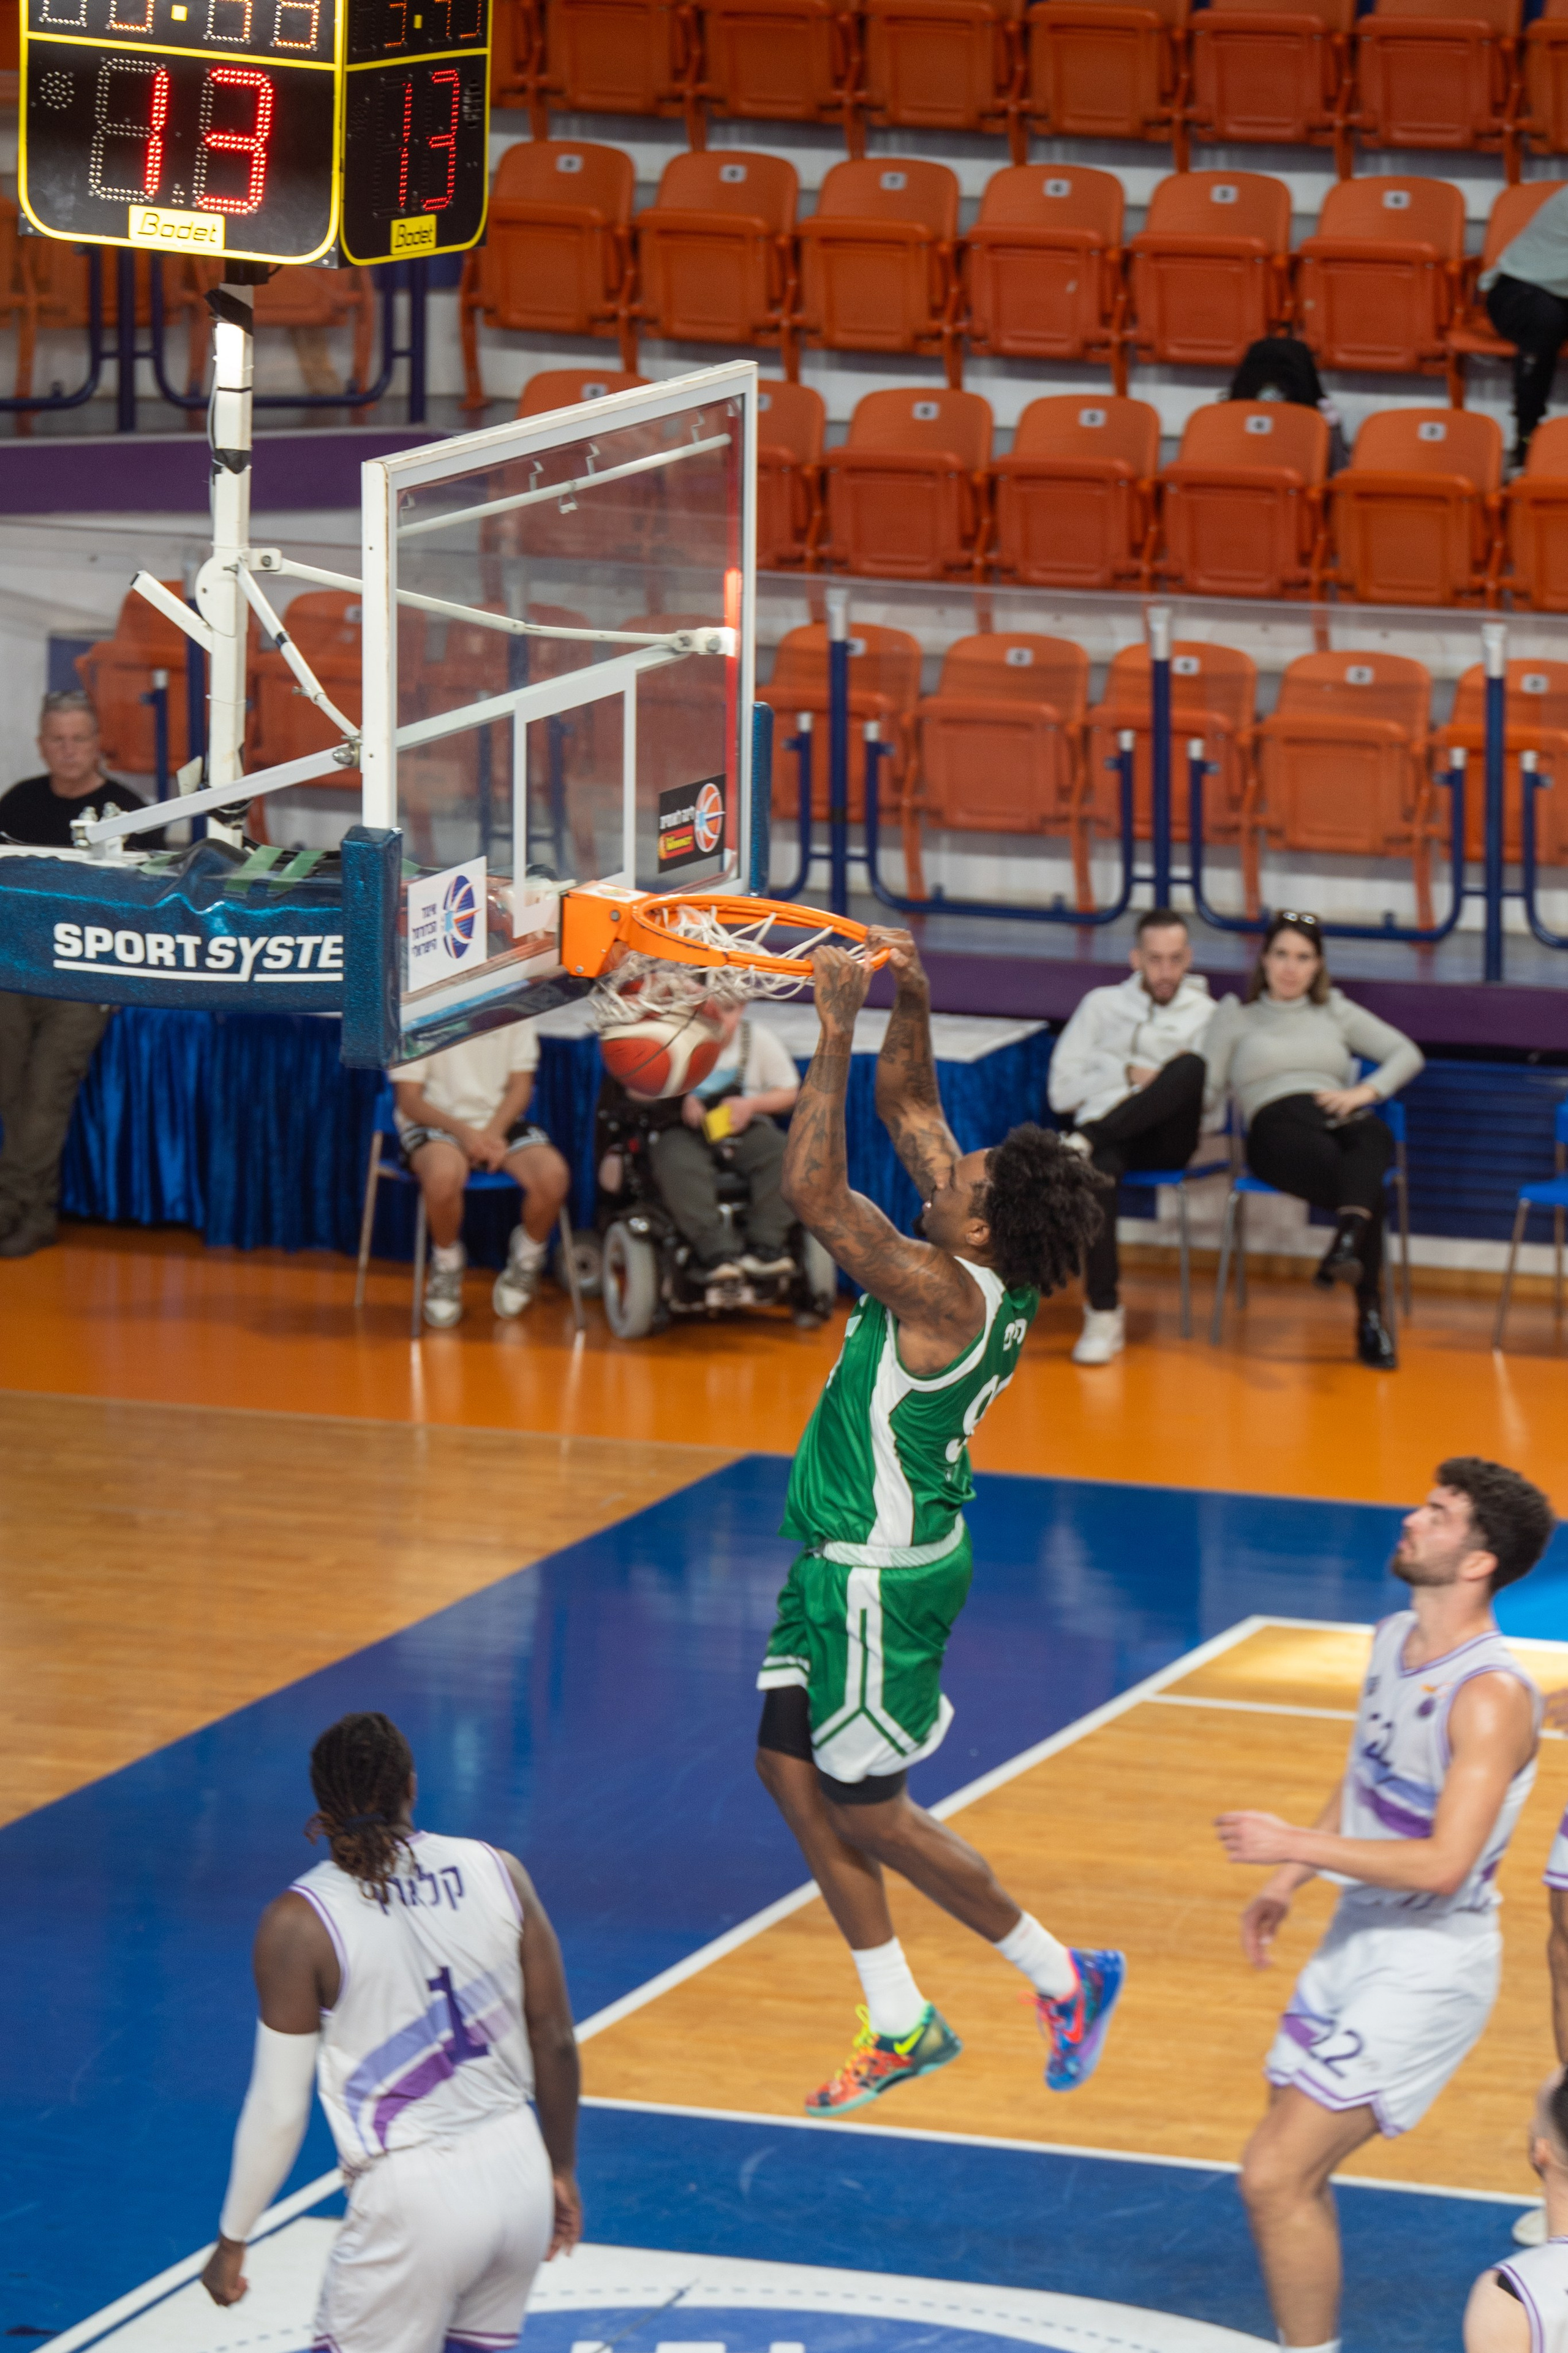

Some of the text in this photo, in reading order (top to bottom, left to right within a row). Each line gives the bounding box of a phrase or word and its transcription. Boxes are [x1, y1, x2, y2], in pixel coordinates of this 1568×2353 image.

[145, 66, 274, 214] 13
[399, 69, 461, 211] 13
[137, 212, 216, 242] Bodet
[394, 224, 432, 248] Bodet
[427, 1966, 491, 2065] 1
